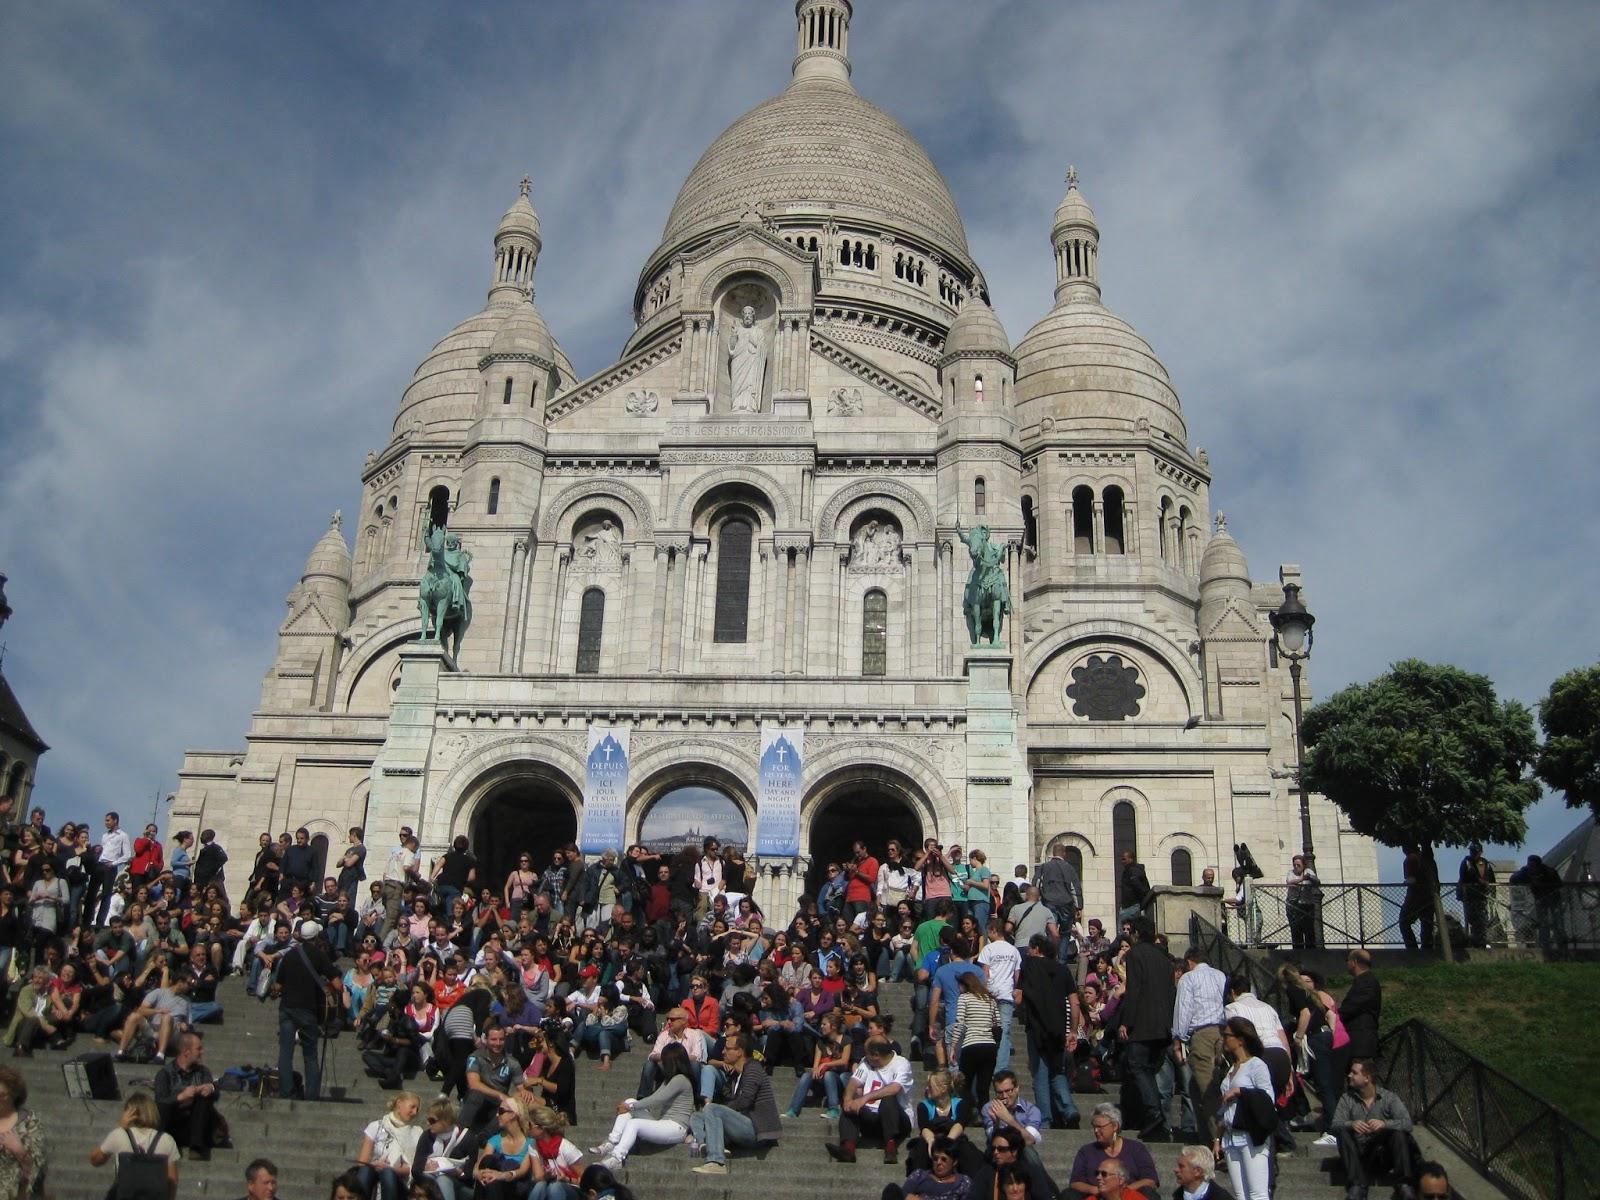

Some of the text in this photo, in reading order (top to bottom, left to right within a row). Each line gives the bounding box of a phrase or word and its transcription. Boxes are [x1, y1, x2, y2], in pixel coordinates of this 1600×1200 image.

[591, 762, 624, 770] DEPUIS
[599, 779, 613, 787] ICI
[768, 779, 793, 788] HERE
